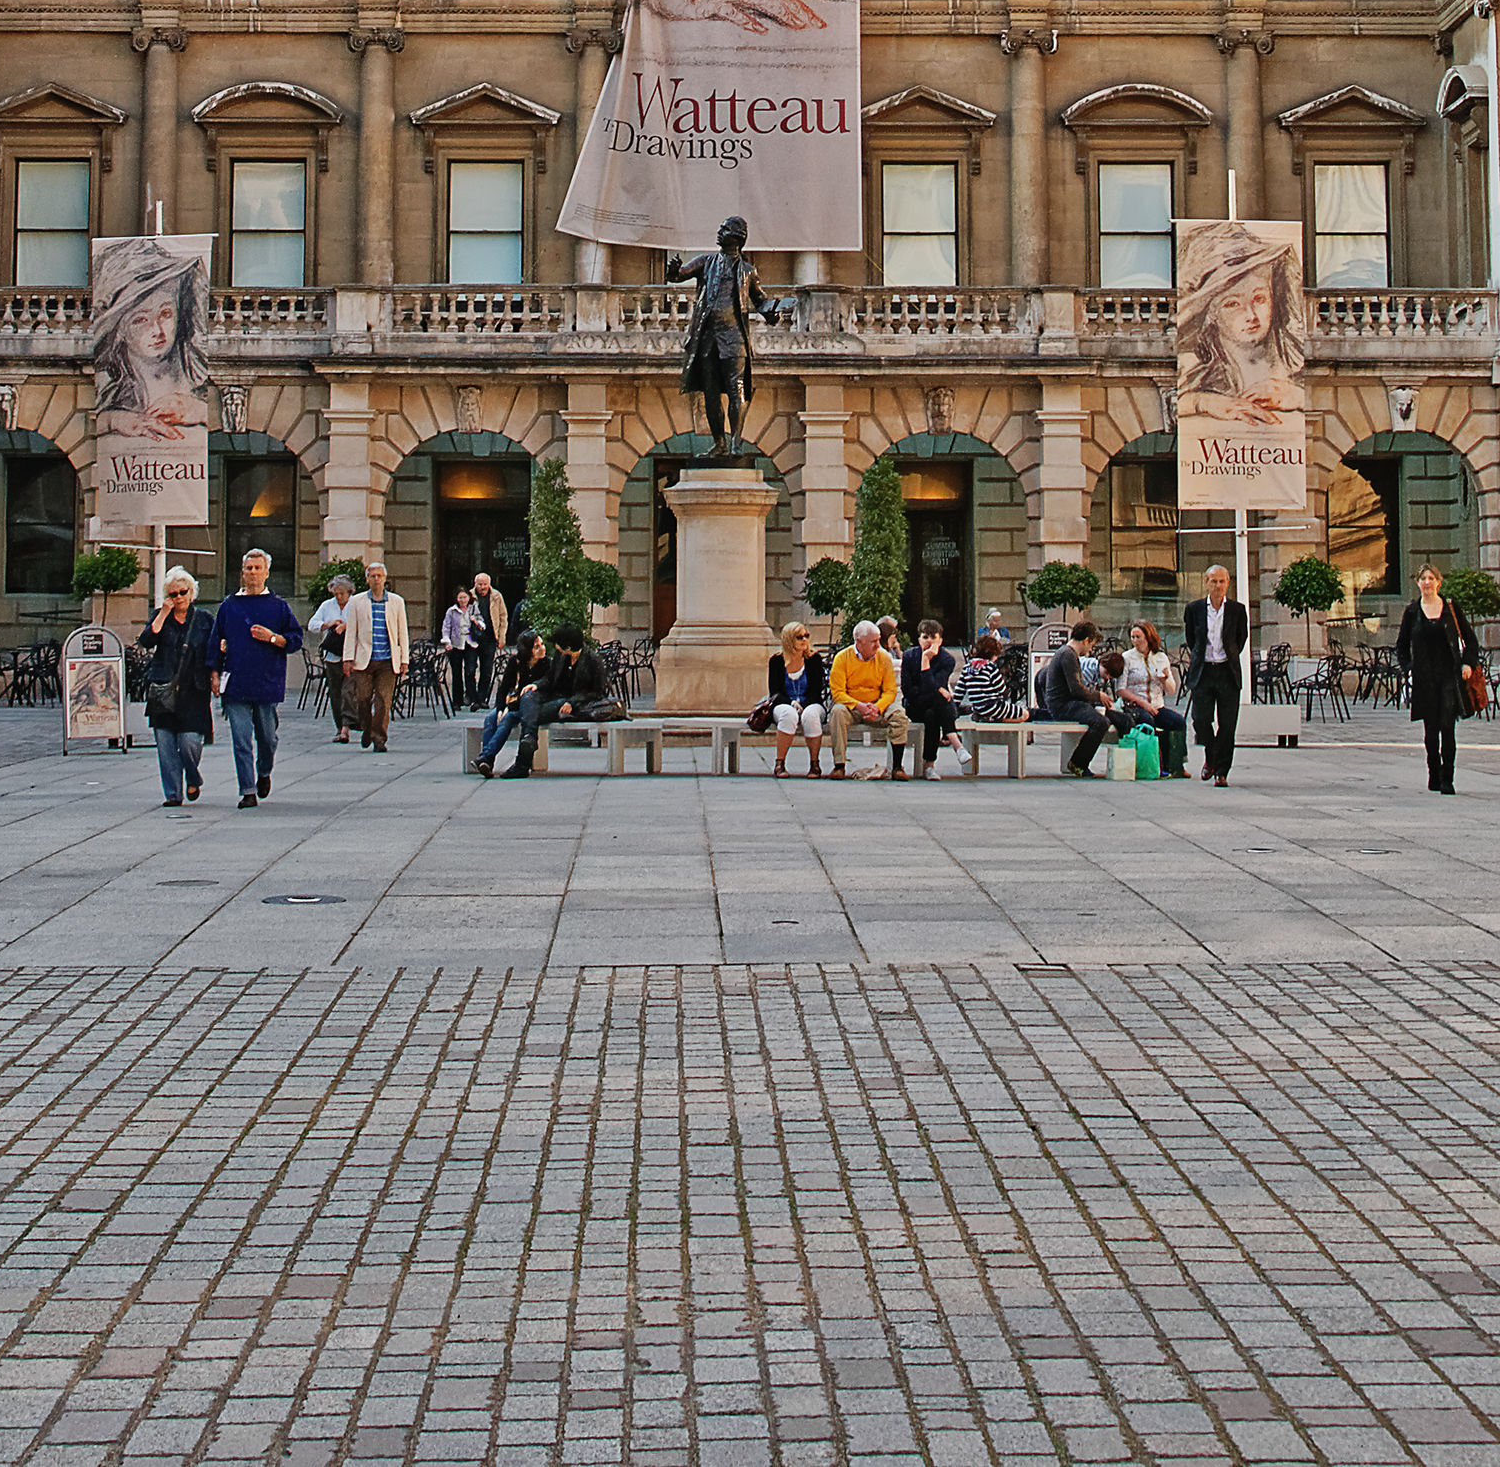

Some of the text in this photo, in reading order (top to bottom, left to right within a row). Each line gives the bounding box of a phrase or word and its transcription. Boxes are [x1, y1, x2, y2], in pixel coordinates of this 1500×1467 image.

[632, 72, 851, 134] Watteau
[608, 119, 753, 169] Drawings
[566, 334, 637, 349] ROYAL
[1198, 438, 1304, 465] Watteau
[111, 455, 206, 482] Watteau
[1191, 460, 1262, 480] Drawings
[106, 479, 164, 496] Drawings
